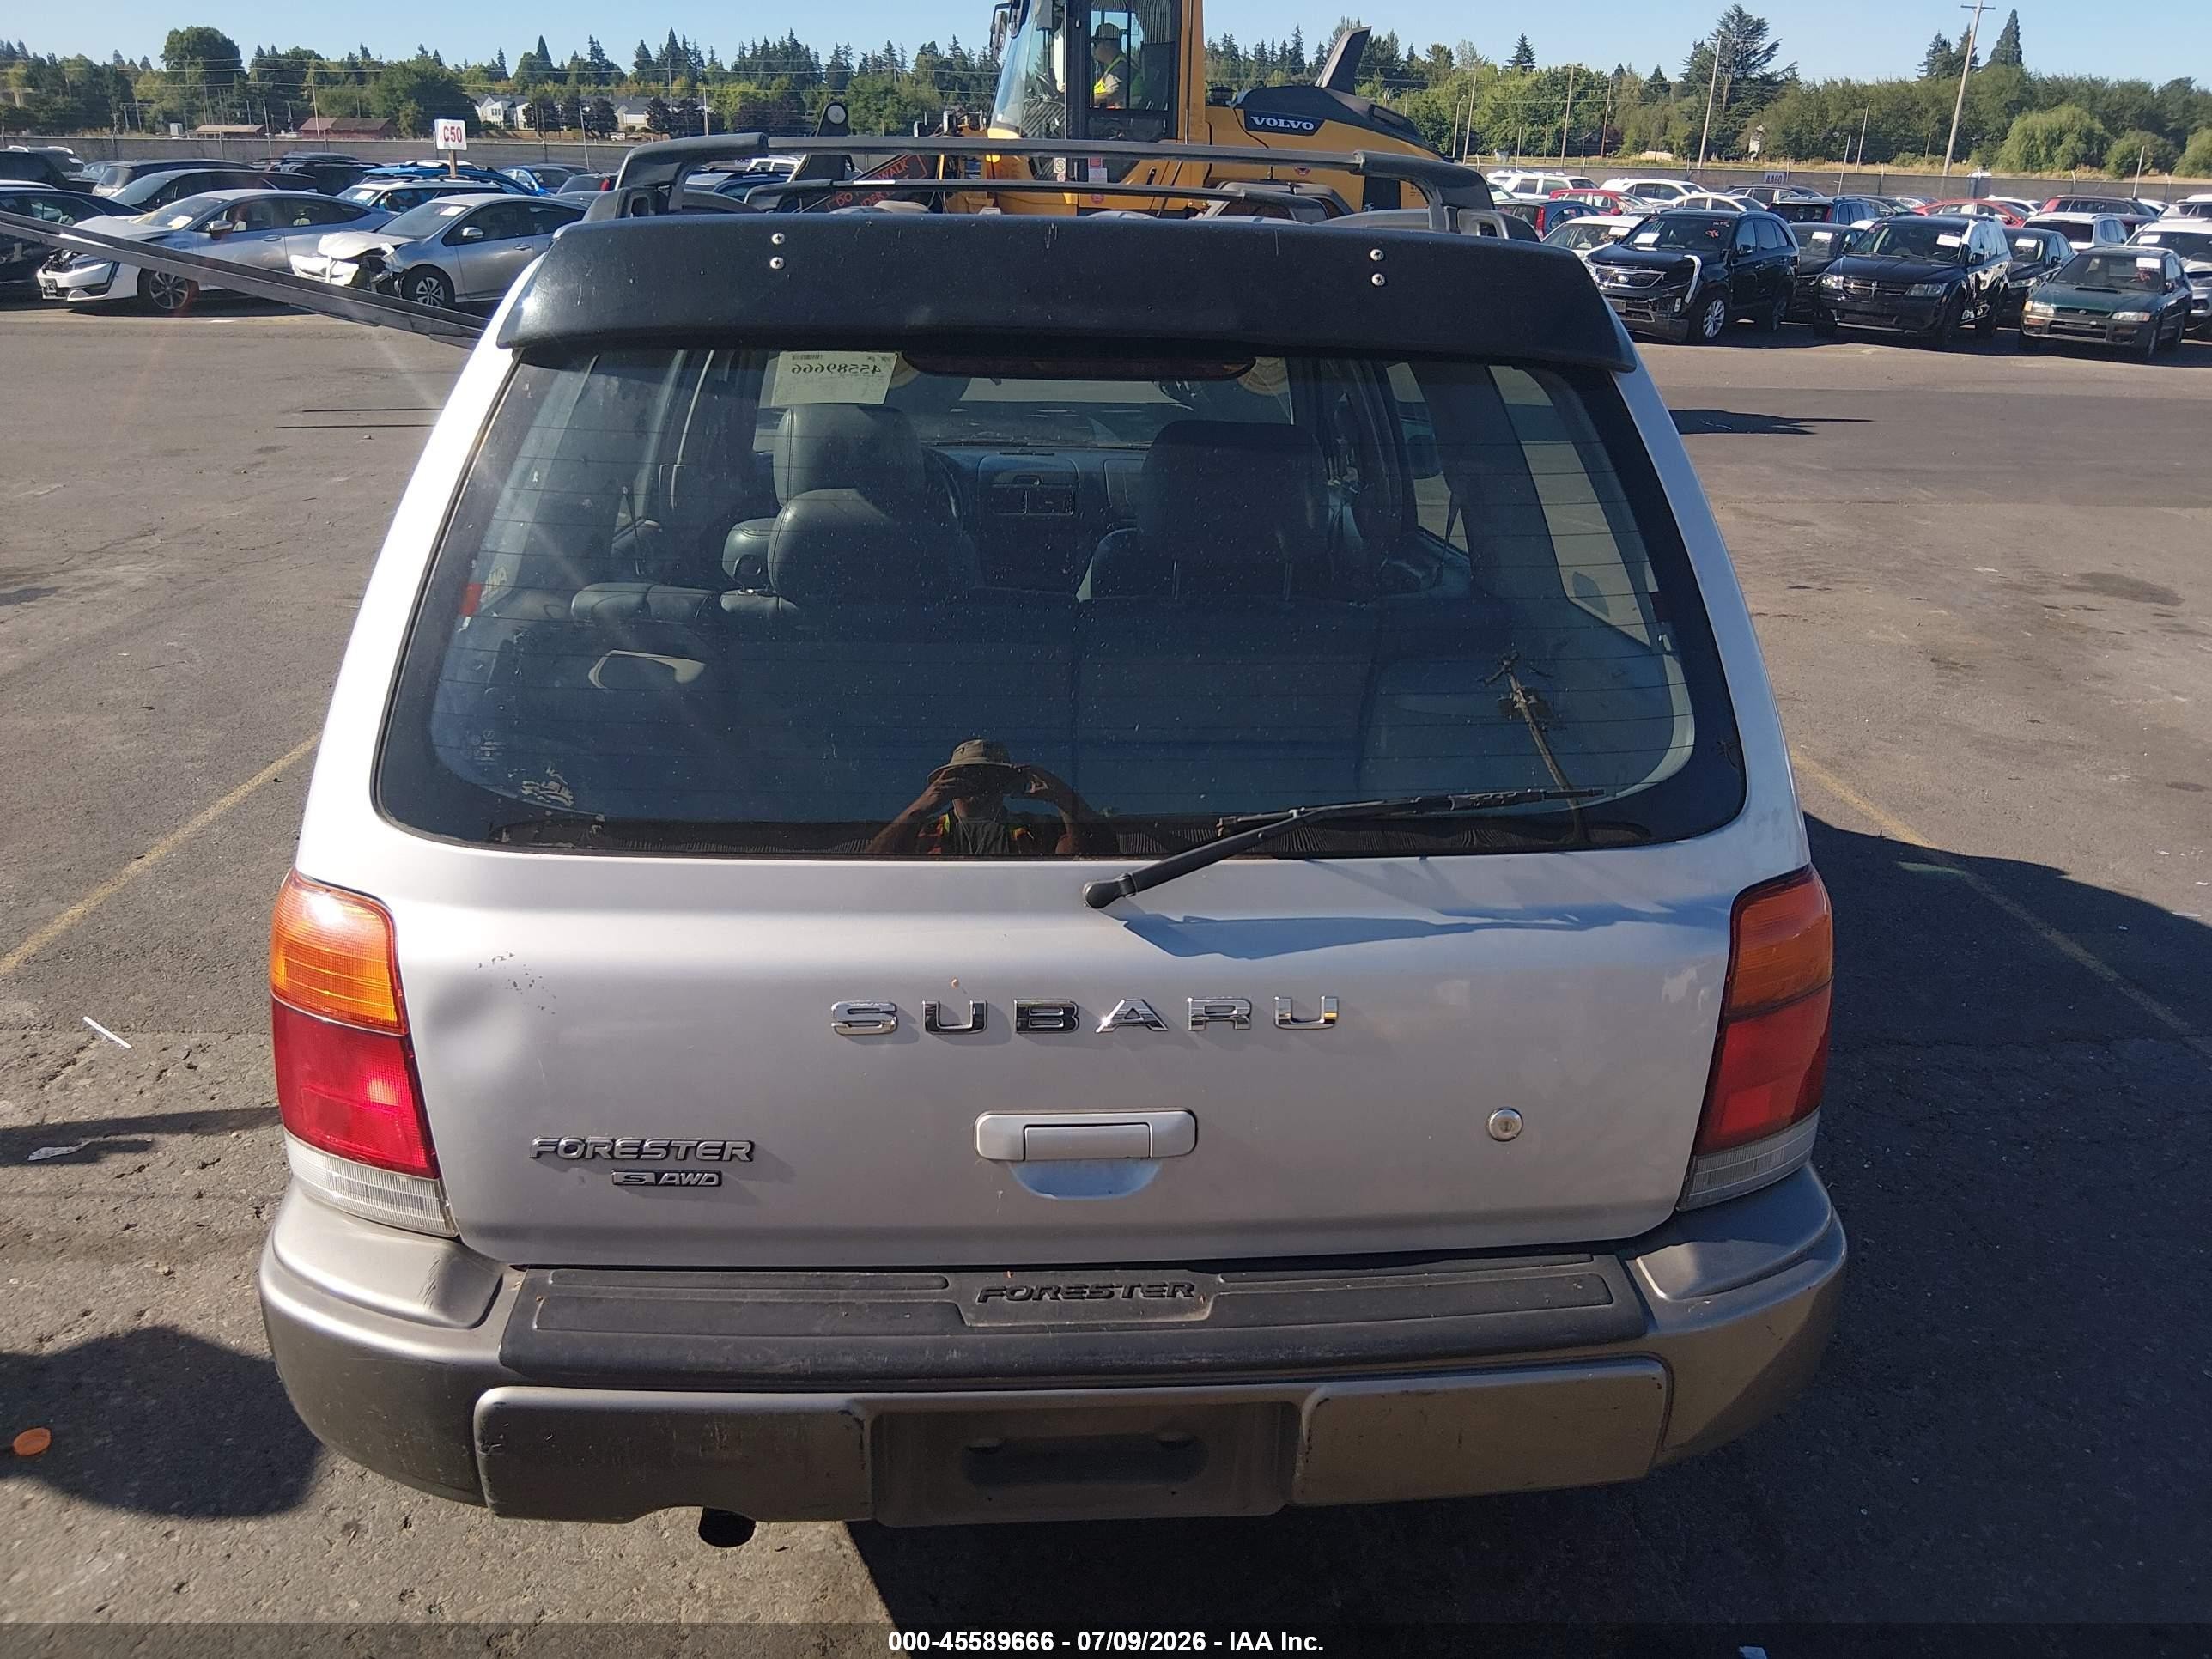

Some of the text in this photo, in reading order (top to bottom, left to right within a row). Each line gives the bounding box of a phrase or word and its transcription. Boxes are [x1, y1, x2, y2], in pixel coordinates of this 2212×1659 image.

[1250, 116, 1315, 131] VOLVO
[878, 159, 909, 179] WALK
[830, 996, 1340, 1034] SUBARU
[529, 1136, 756, 1162] FORESTER
[658, 1172, 720, 1187] AWD
[976, 1281, 1196, 1304] FORESTER
